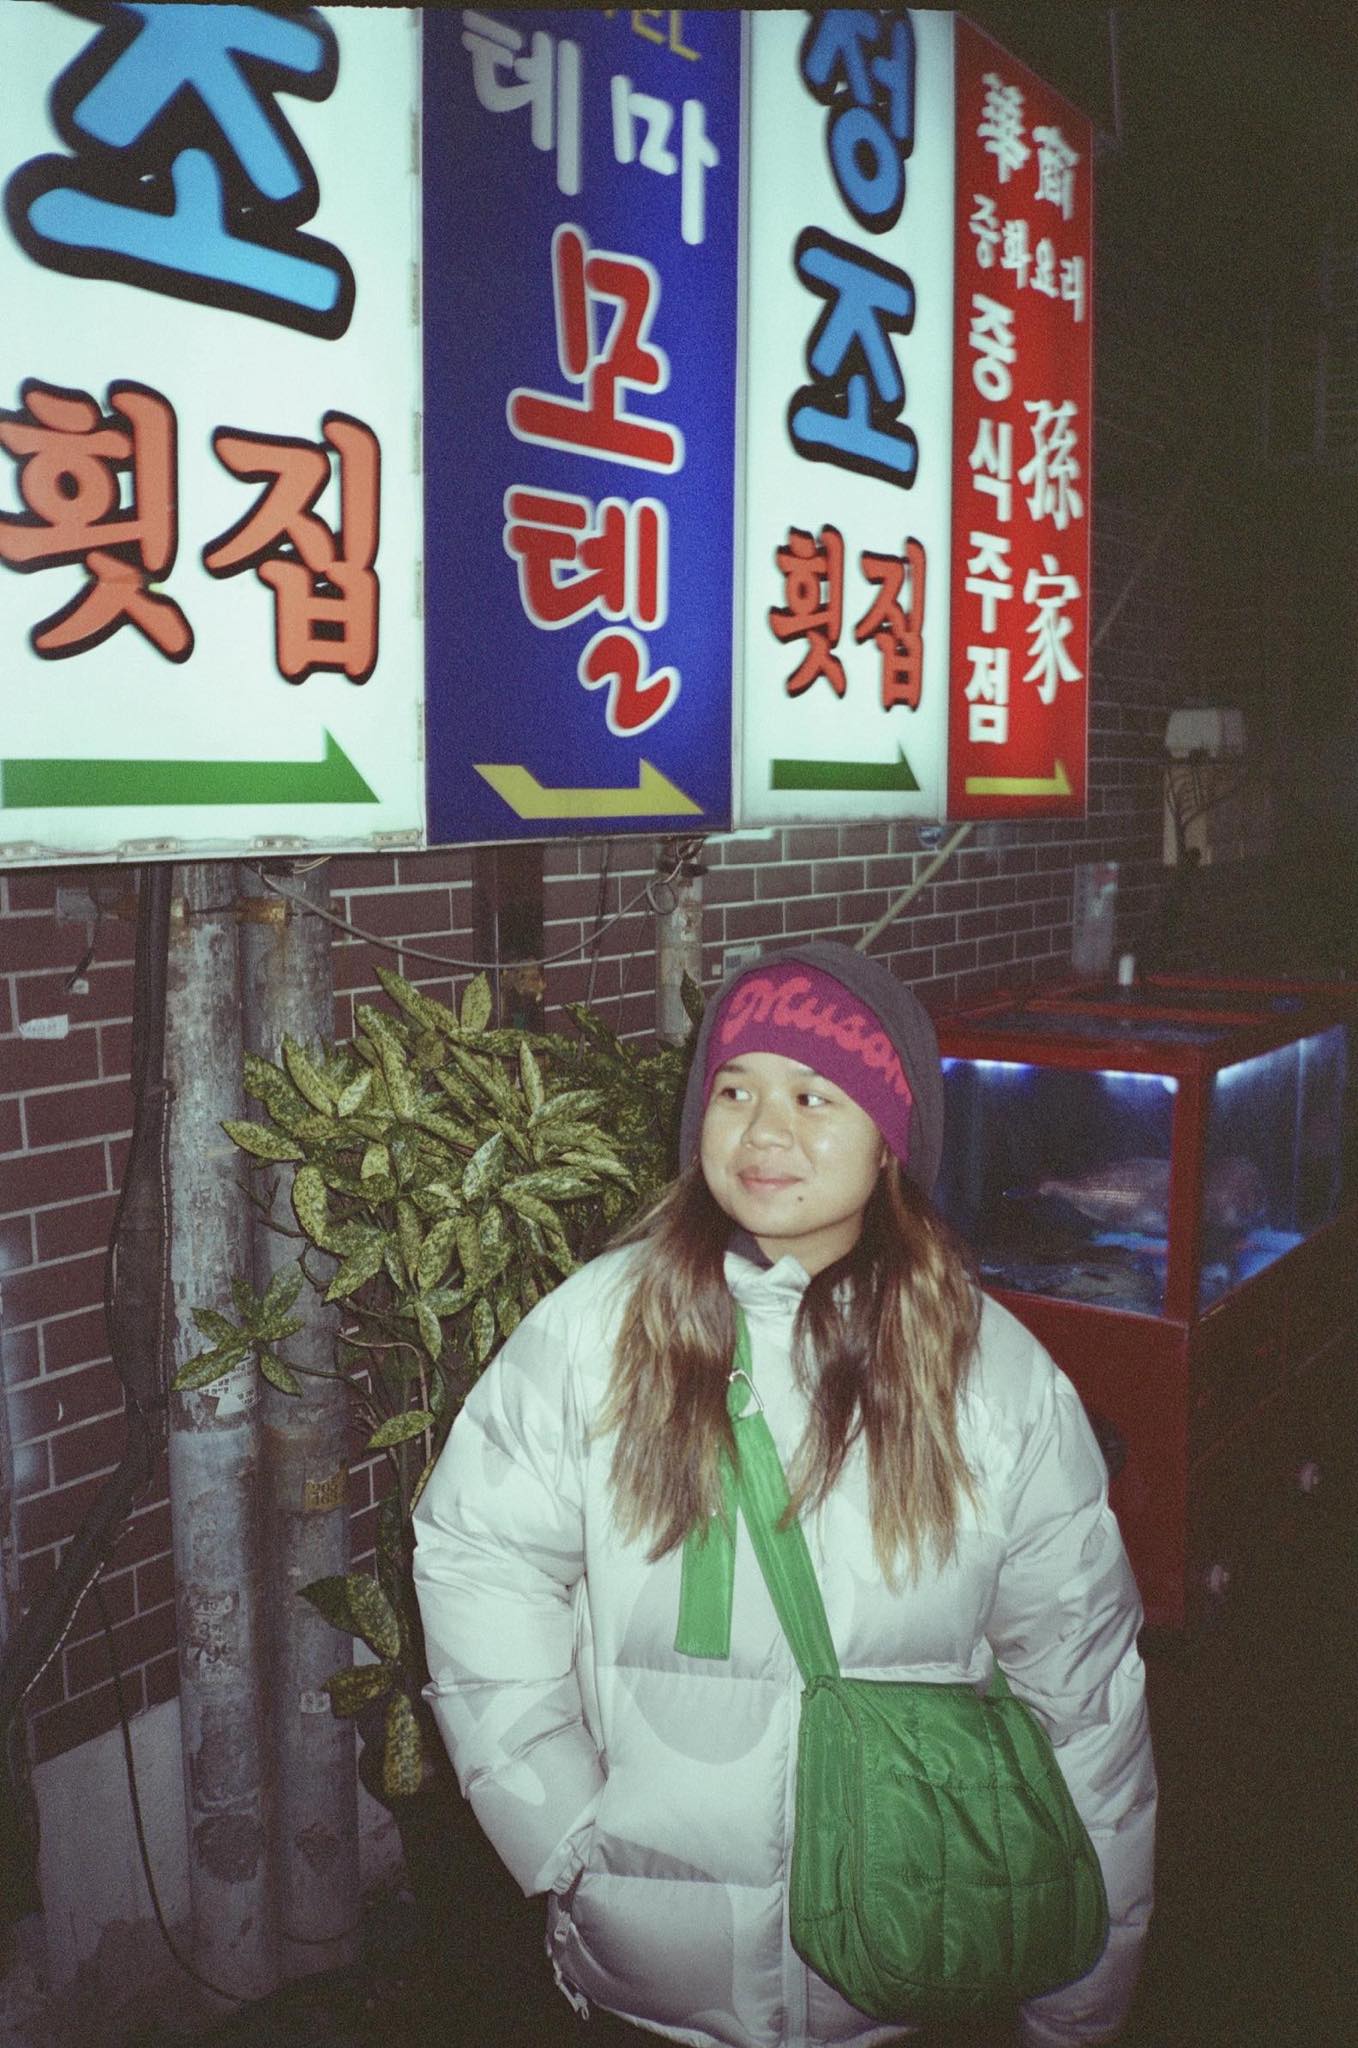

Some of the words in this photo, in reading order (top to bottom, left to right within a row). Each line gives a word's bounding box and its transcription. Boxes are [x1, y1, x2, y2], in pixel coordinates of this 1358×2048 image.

[461, 9, 720, 246] 테마
[0, 376, 382, 686] 횟집
[502, 222, 686, 738] 모텔
[768, 523, 926, 714] 횟집
[963, 293, 1017, 745] 중식주점
[1017, 400, 1085, 705] 孫家
